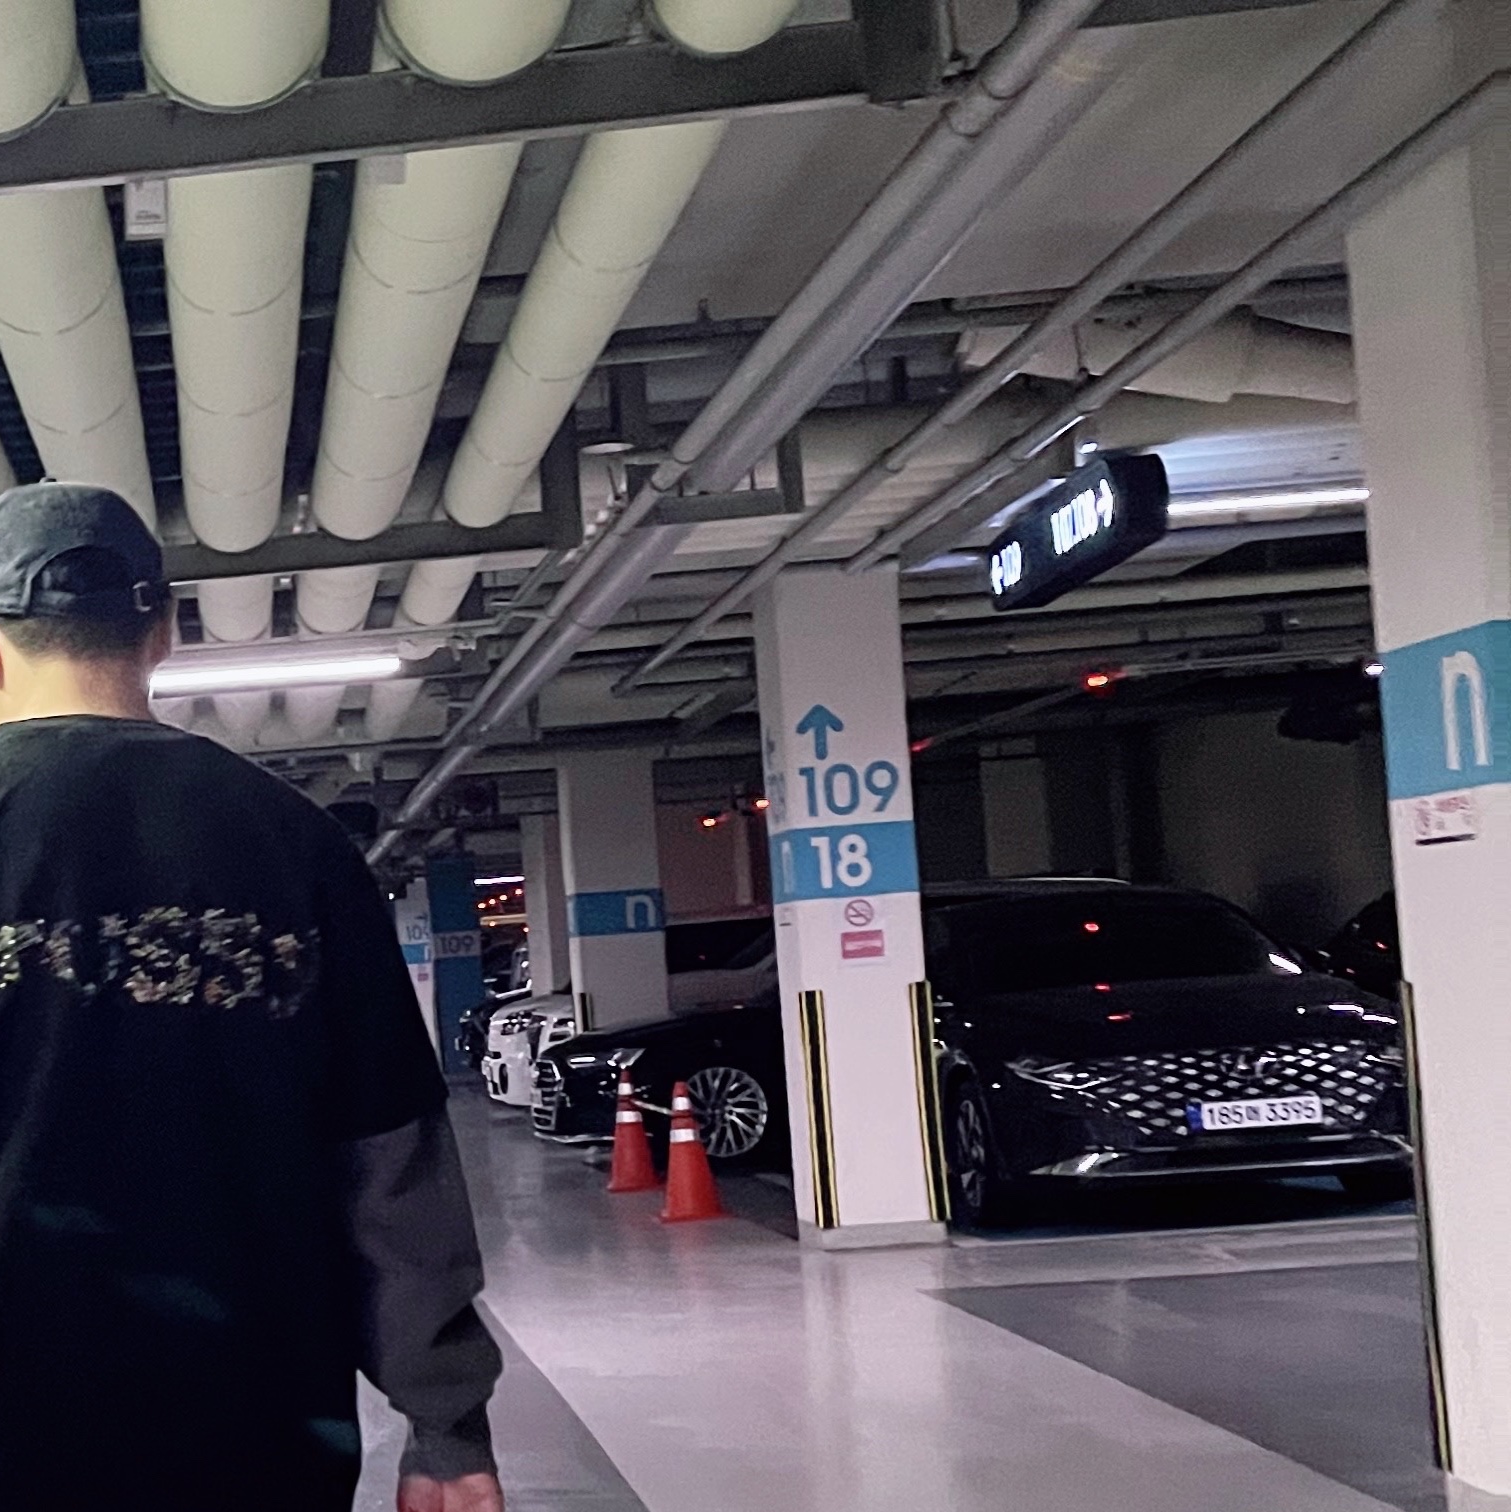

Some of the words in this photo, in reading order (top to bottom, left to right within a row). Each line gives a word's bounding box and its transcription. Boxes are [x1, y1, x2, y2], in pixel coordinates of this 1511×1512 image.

[1441, 651, 1490, 770] n
[798, 760, 899, 817] 109
[811, 834, 872, 889] 18
[626, 894, 656, 929] n
